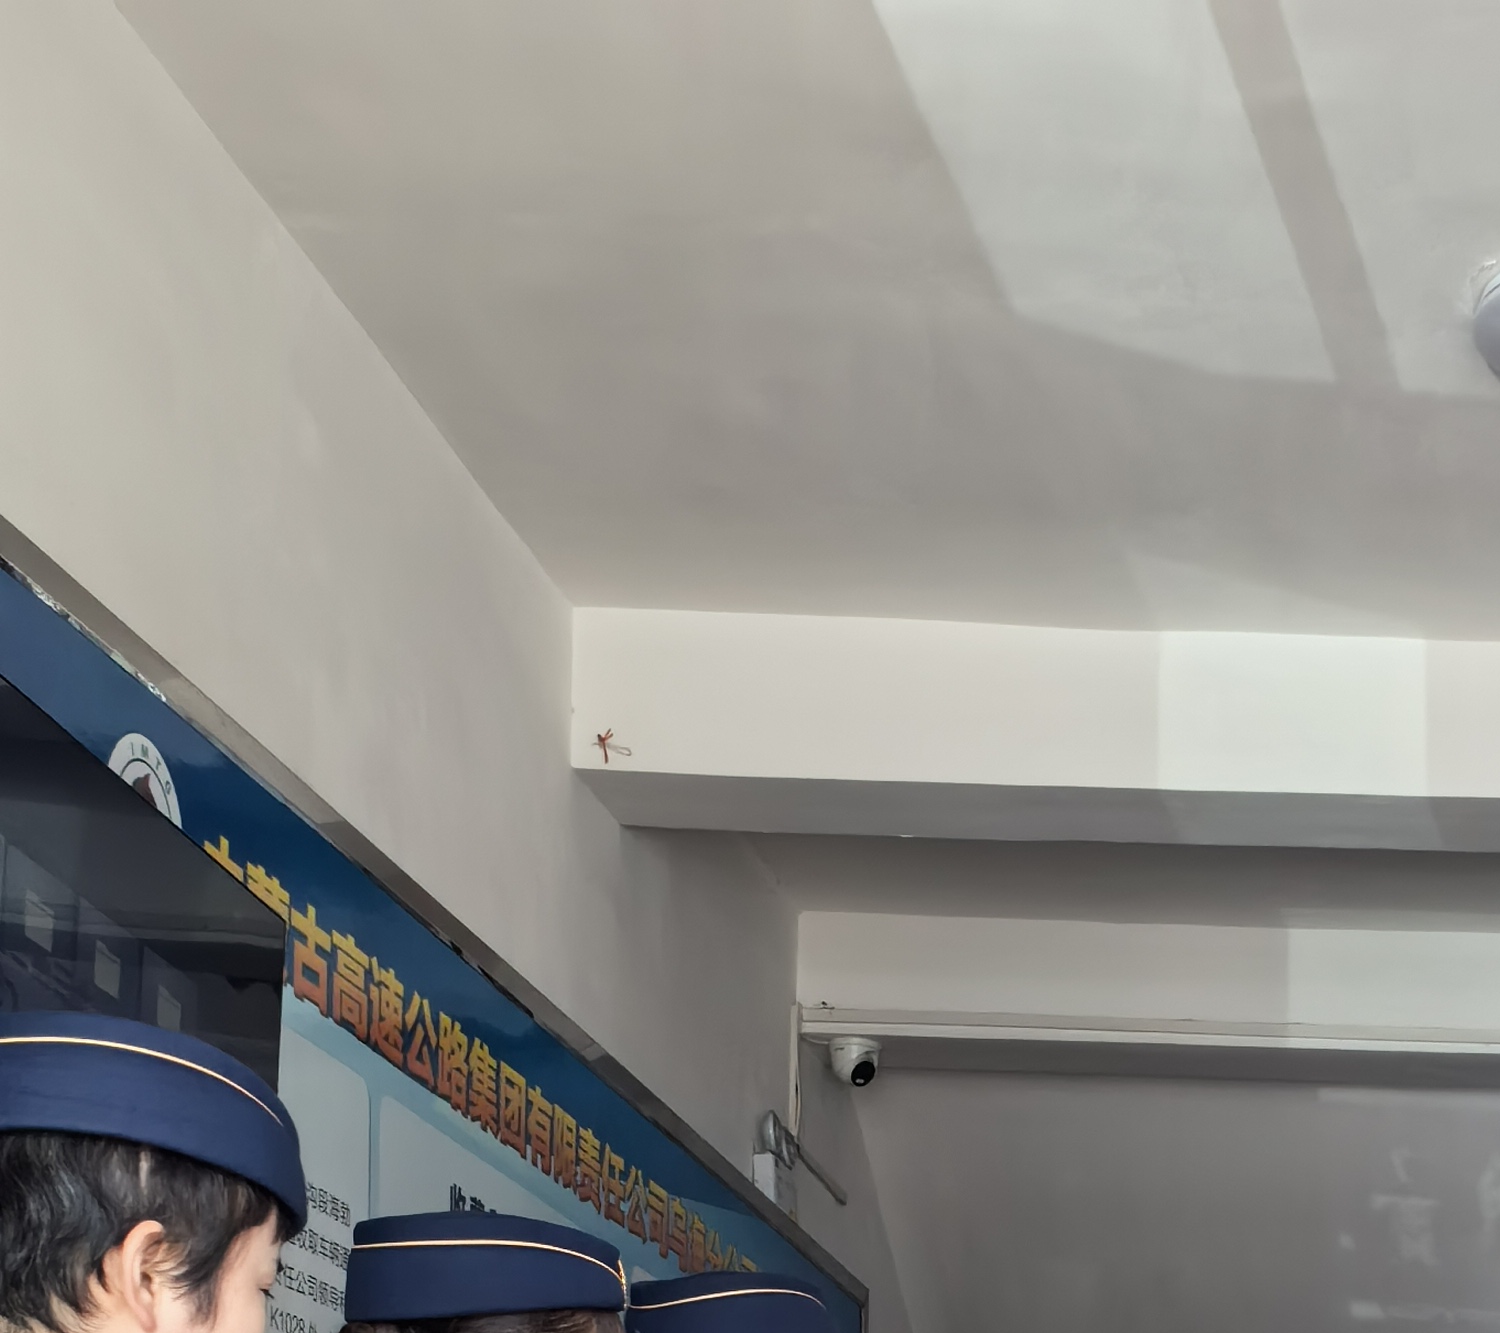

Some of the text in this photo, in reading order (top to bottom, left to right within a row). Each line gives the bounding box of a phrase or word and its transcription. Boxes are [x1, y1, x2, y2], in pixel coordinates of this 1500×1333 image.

[275, 1263, 345, 1315] 任公司领导
